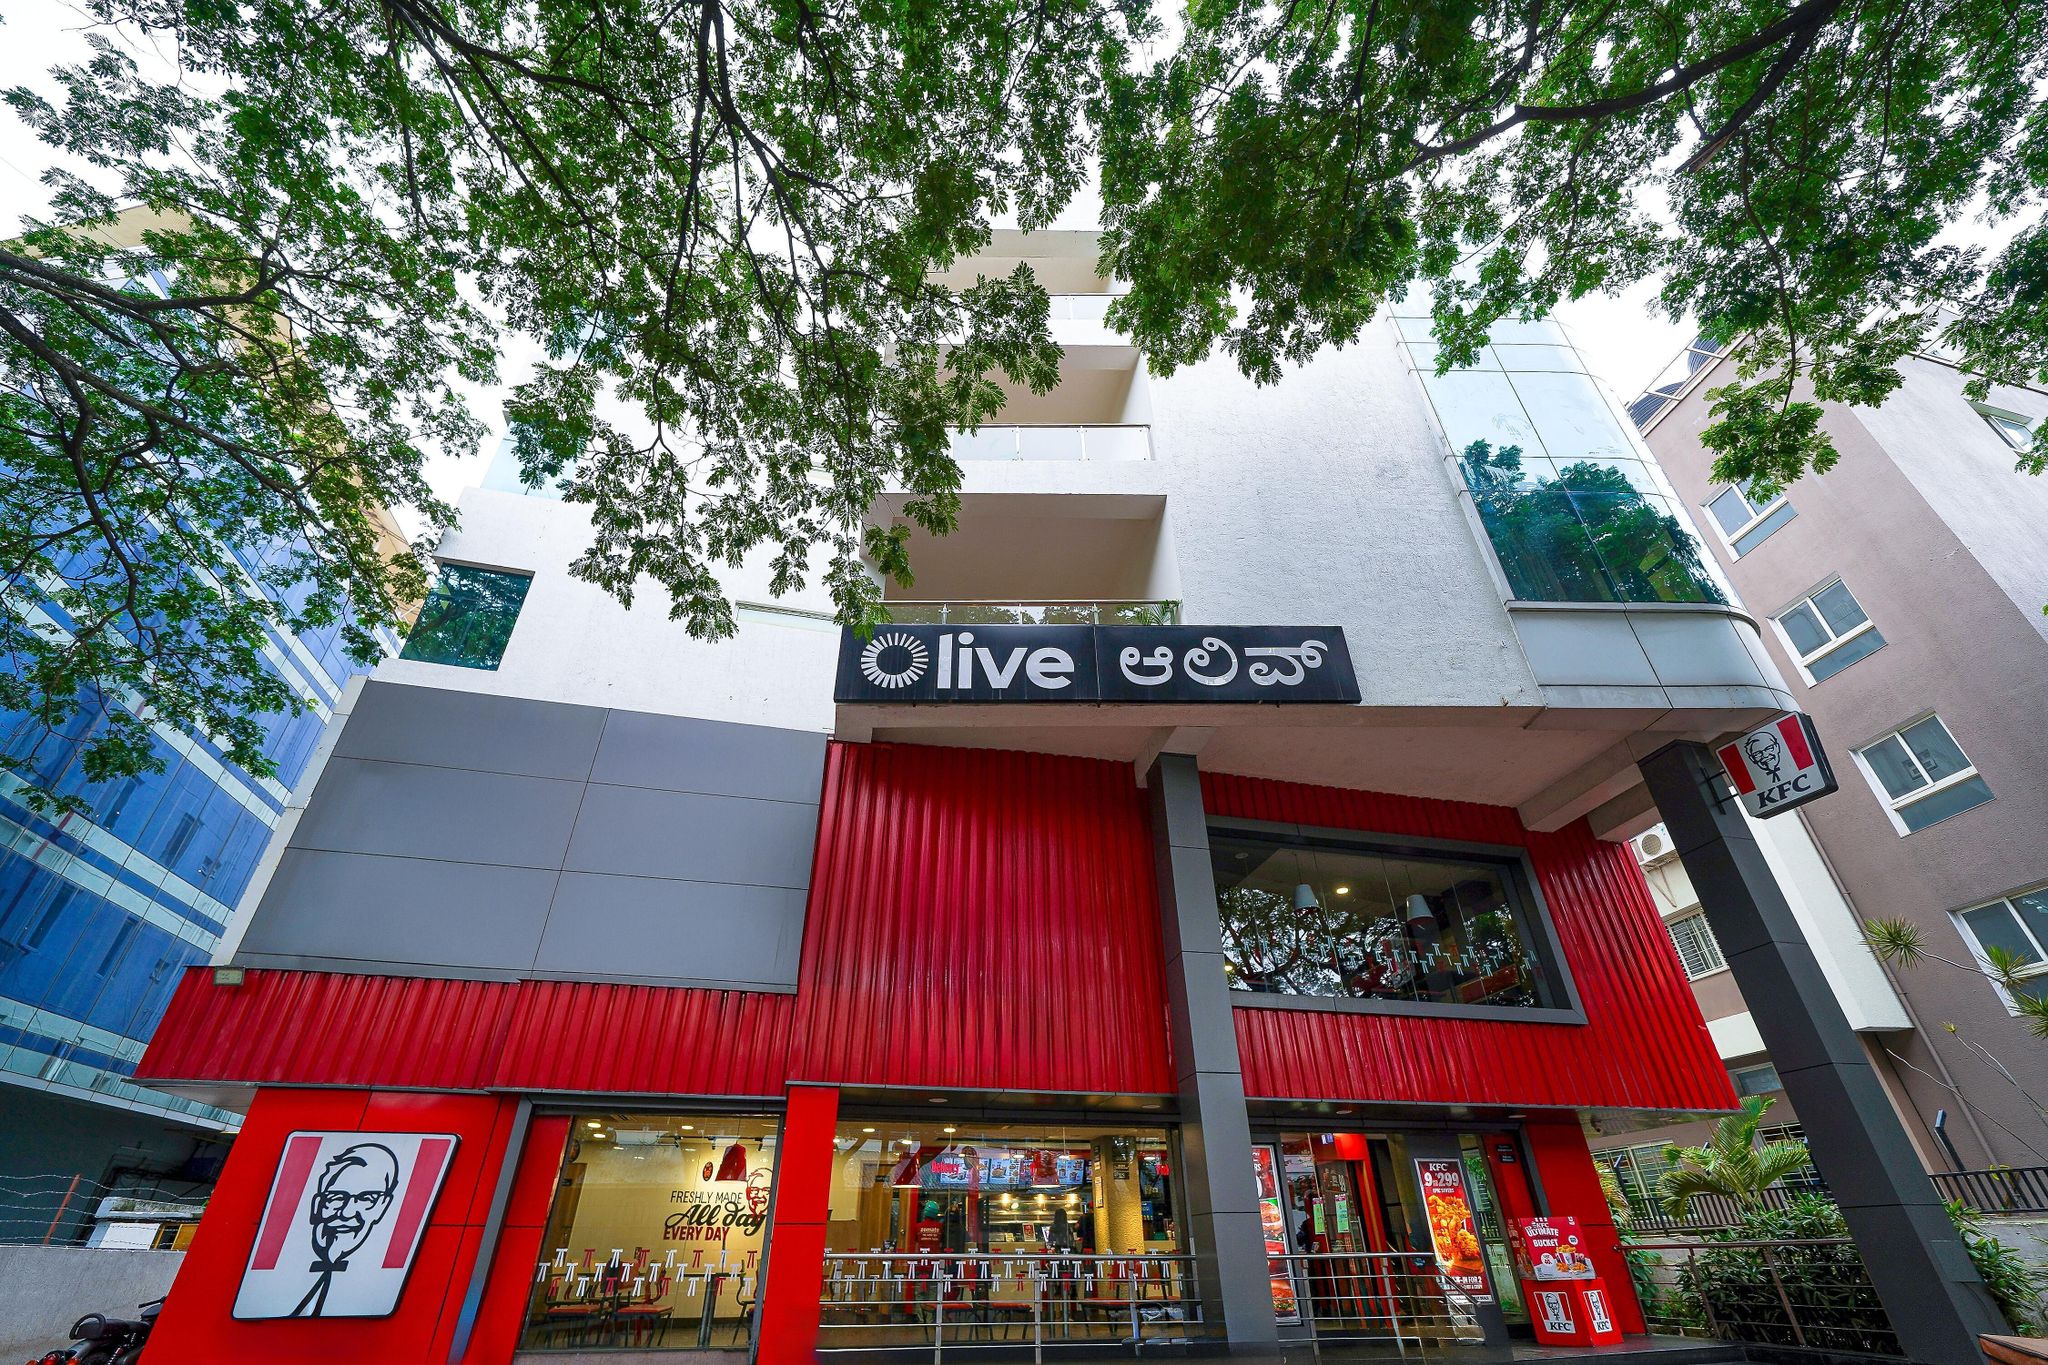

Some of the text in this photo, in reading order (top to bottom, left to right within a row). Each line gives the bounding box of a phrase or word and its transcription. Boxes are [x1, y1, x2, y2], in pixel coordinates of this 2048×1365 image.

[860, 632, 1075, 689] Olive
[1756, 773, 1811, 810] KFC
[1429, 1163, 1448, 1172] KFC
[1424, 1172, 1433, 1187] 9
[670, 1190, 743, 1205] FRESHLY MADE
[664, 1201, 767, 1237] All day
[663, 1226, 730, 1241] EVERY DAY
[1525, 1226, 1559, 1237] ULTIMATE
[1533, 1239, 1558, 1247] BUCKET
[1549, 1322, 1571, 1331] KFC
[1596, 1321, 1610, 1331] KFC
